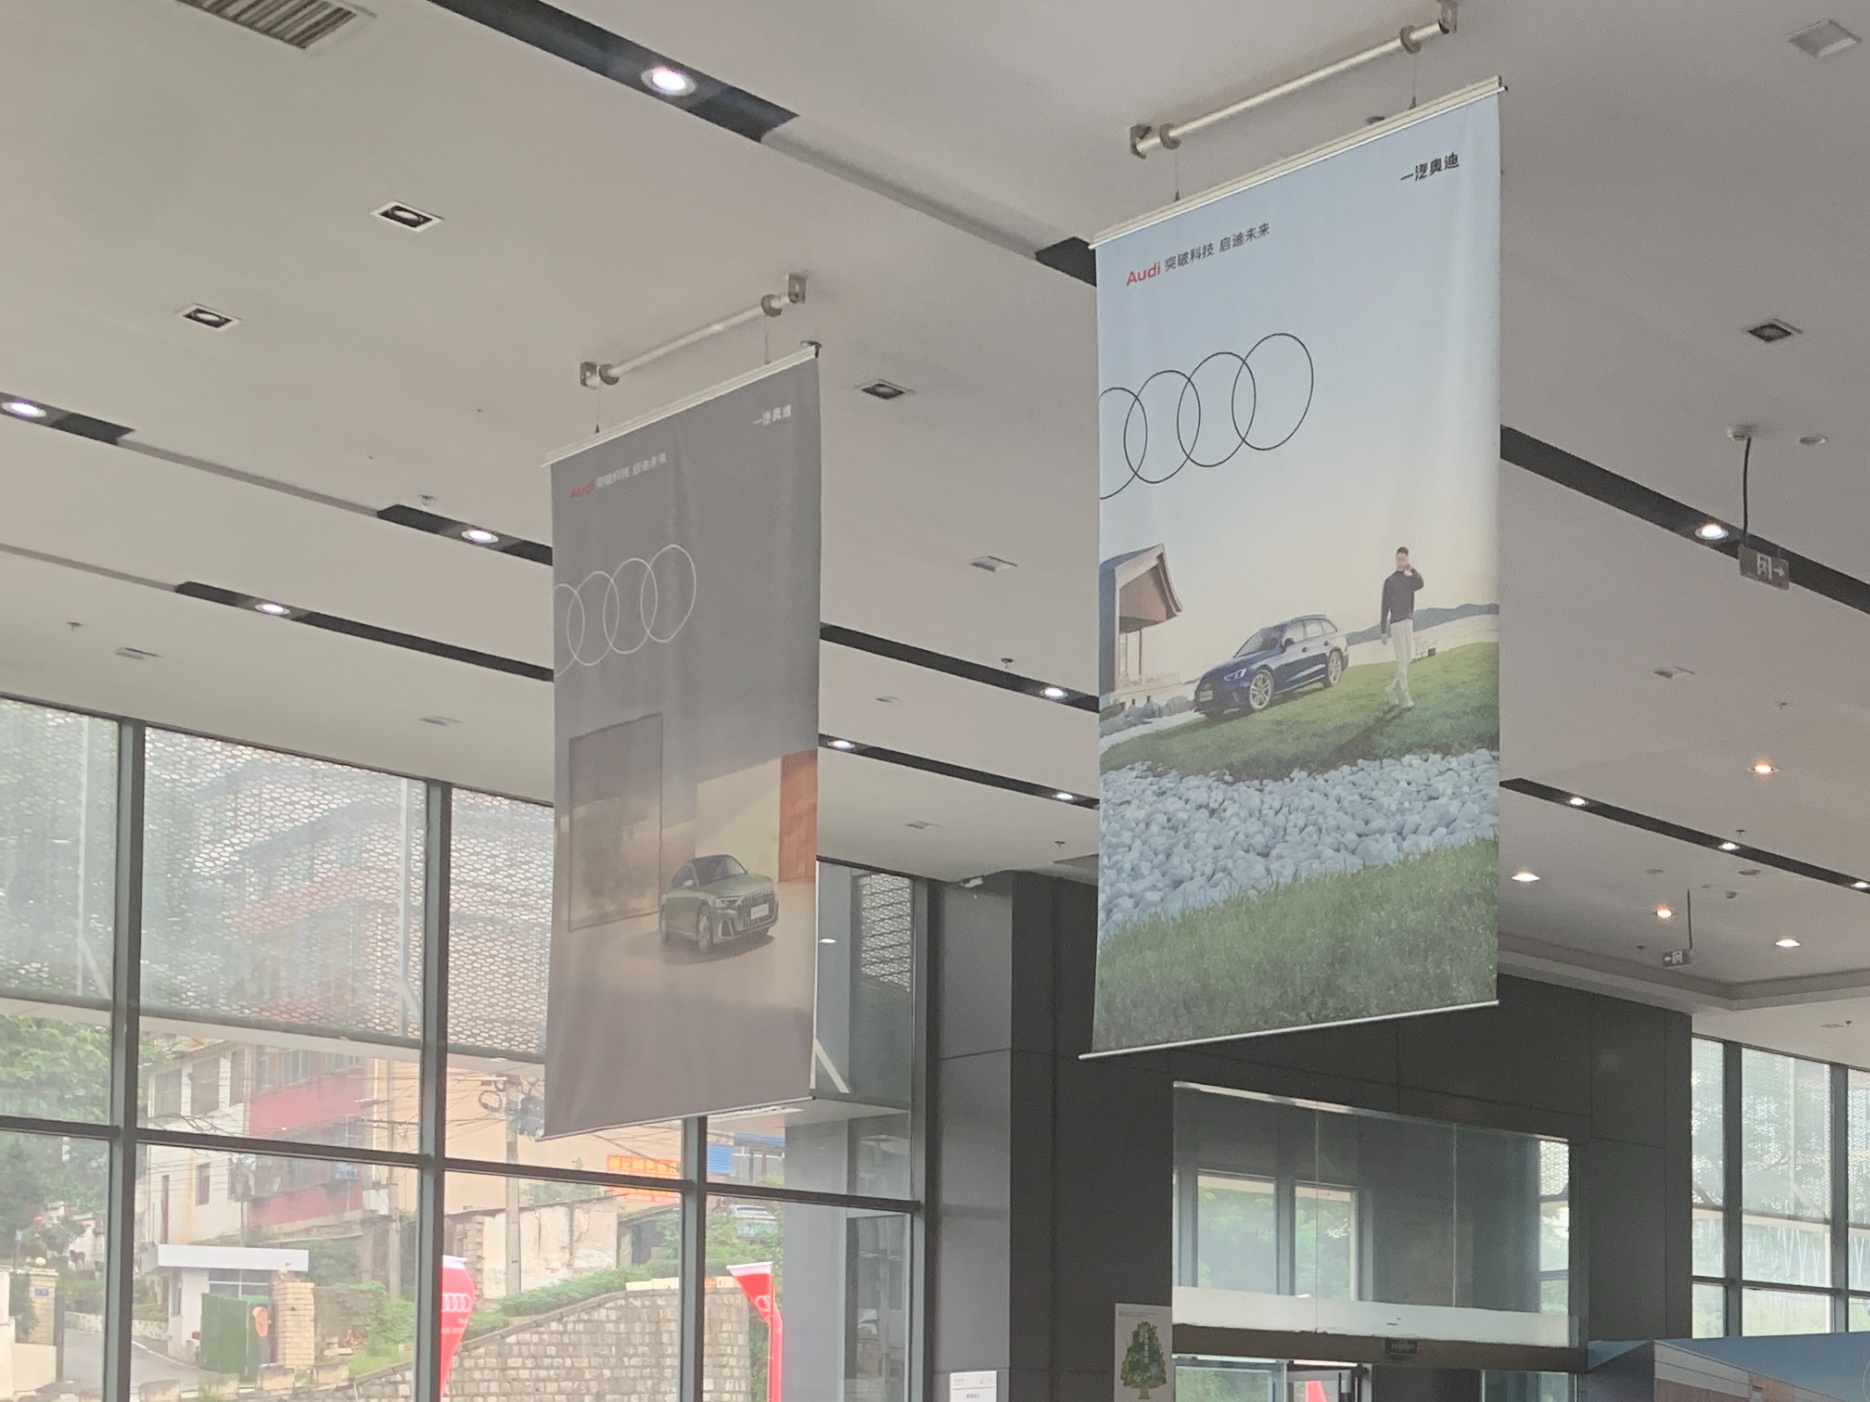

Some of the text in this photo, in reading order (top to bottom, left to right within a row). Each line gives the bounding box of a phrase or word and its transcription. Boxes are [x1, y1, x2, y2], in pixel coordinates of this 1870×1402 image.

[1400, 151, 1460, 181] 一汽奥迪
[1126, 222, 1271, 286] Audi 突破科技 启迪未来
